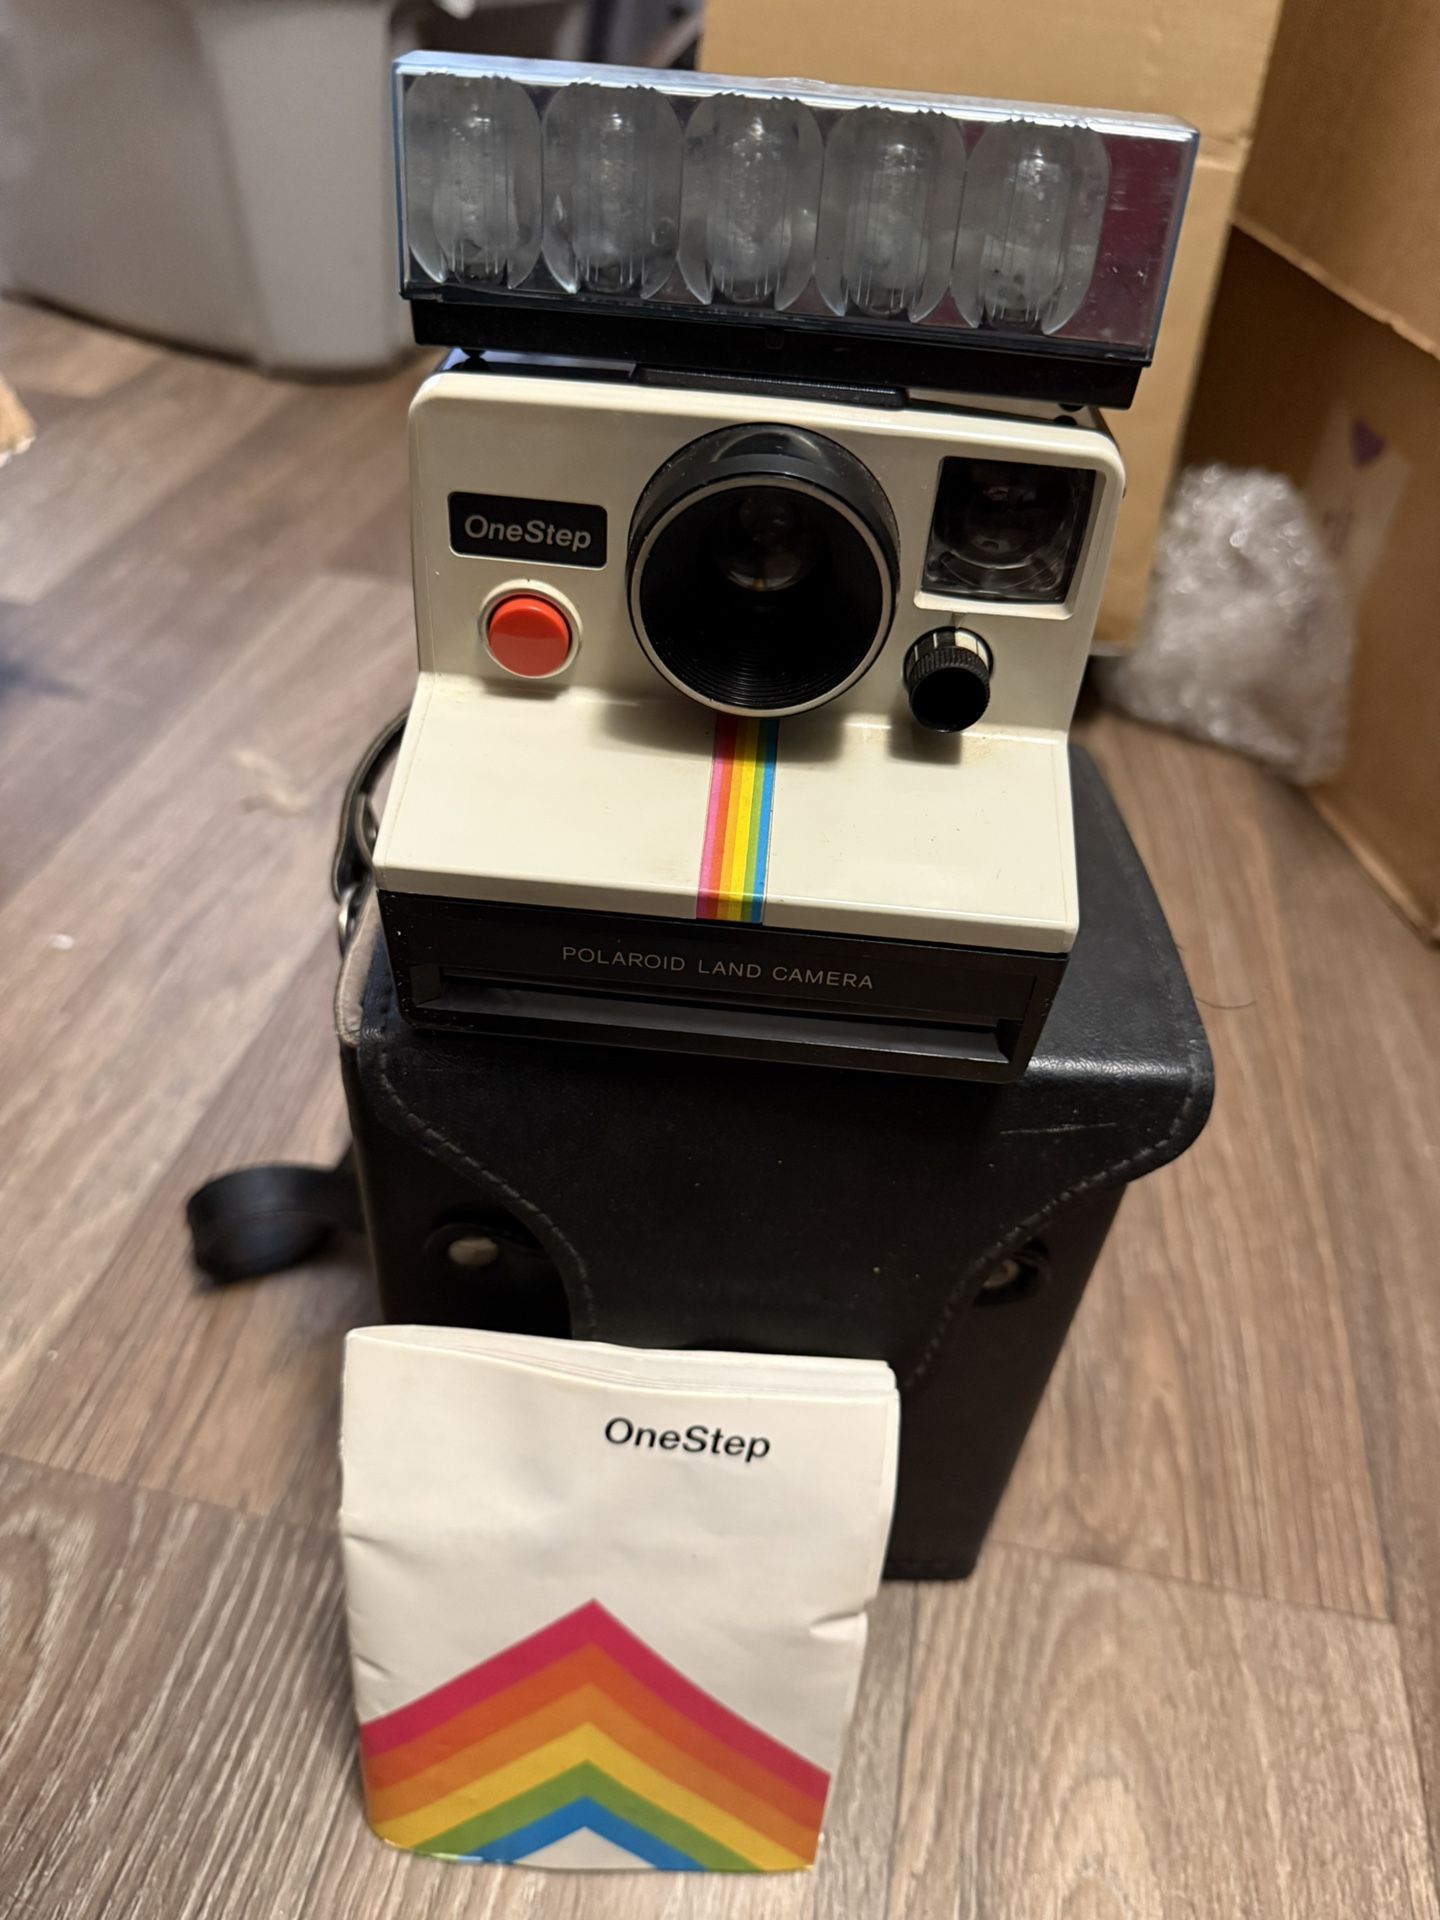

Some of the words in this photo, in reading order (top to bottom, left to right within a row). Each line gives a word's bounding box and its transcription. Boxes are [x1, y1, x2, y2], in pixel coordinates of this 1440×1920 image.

[464, 514, 591, 552] OneStep
[562, 946, 686, 971] POLAROID
[698, 959, 762, 979] LAND
[772, 966, 874, 990] CAMERA
[604, 1417, 771, 1463] OneStep
